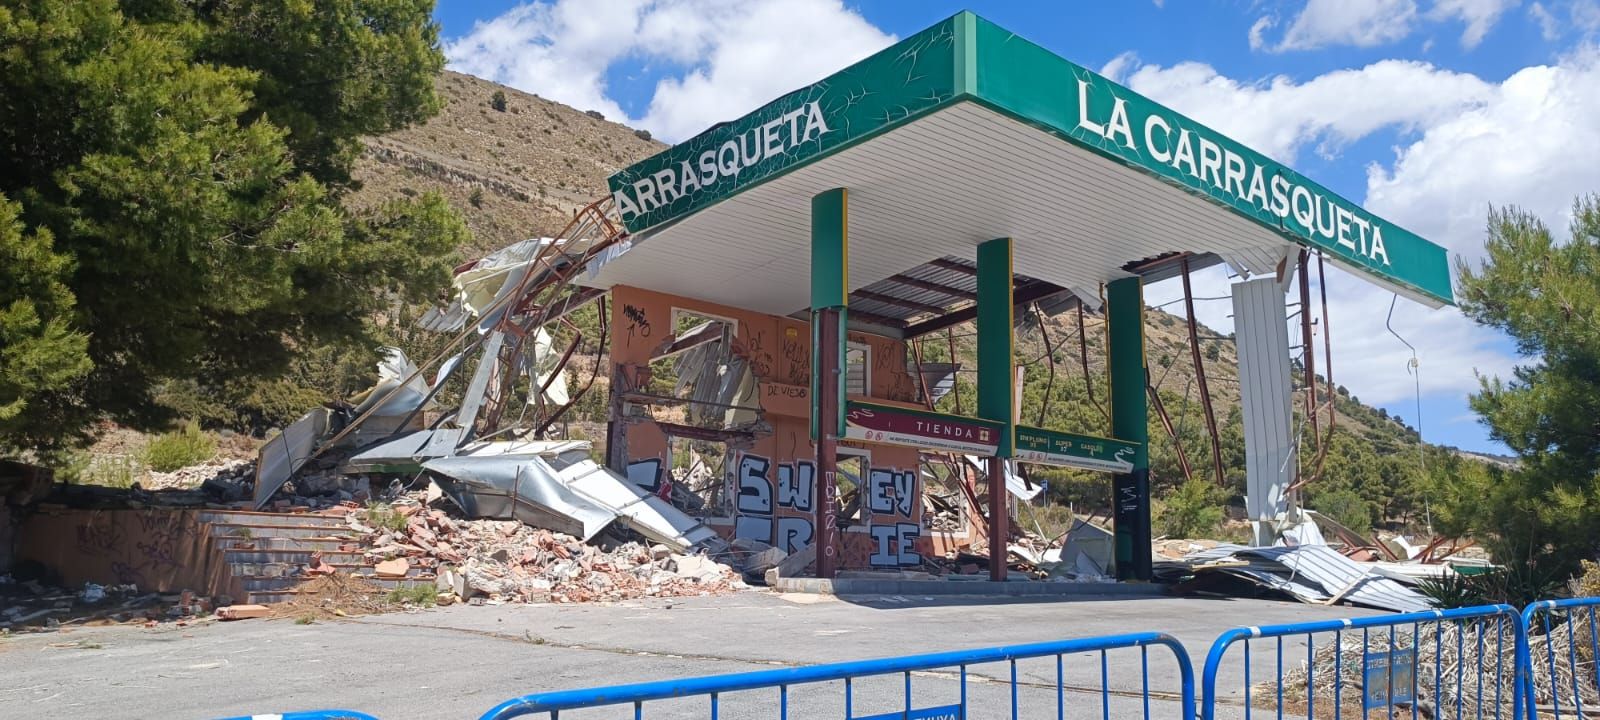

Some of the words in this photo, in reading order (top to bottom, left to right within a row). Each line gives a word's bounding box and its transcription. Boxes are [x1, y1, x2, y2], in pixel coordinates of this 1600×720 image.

[613, 100, 830, 222] ARRASQUETA
[1076, 79, 1137, 150] LA
[1144, 114, 1392, 266] CARRASQUETA
[917, 421, 973, 438] TIENDA
